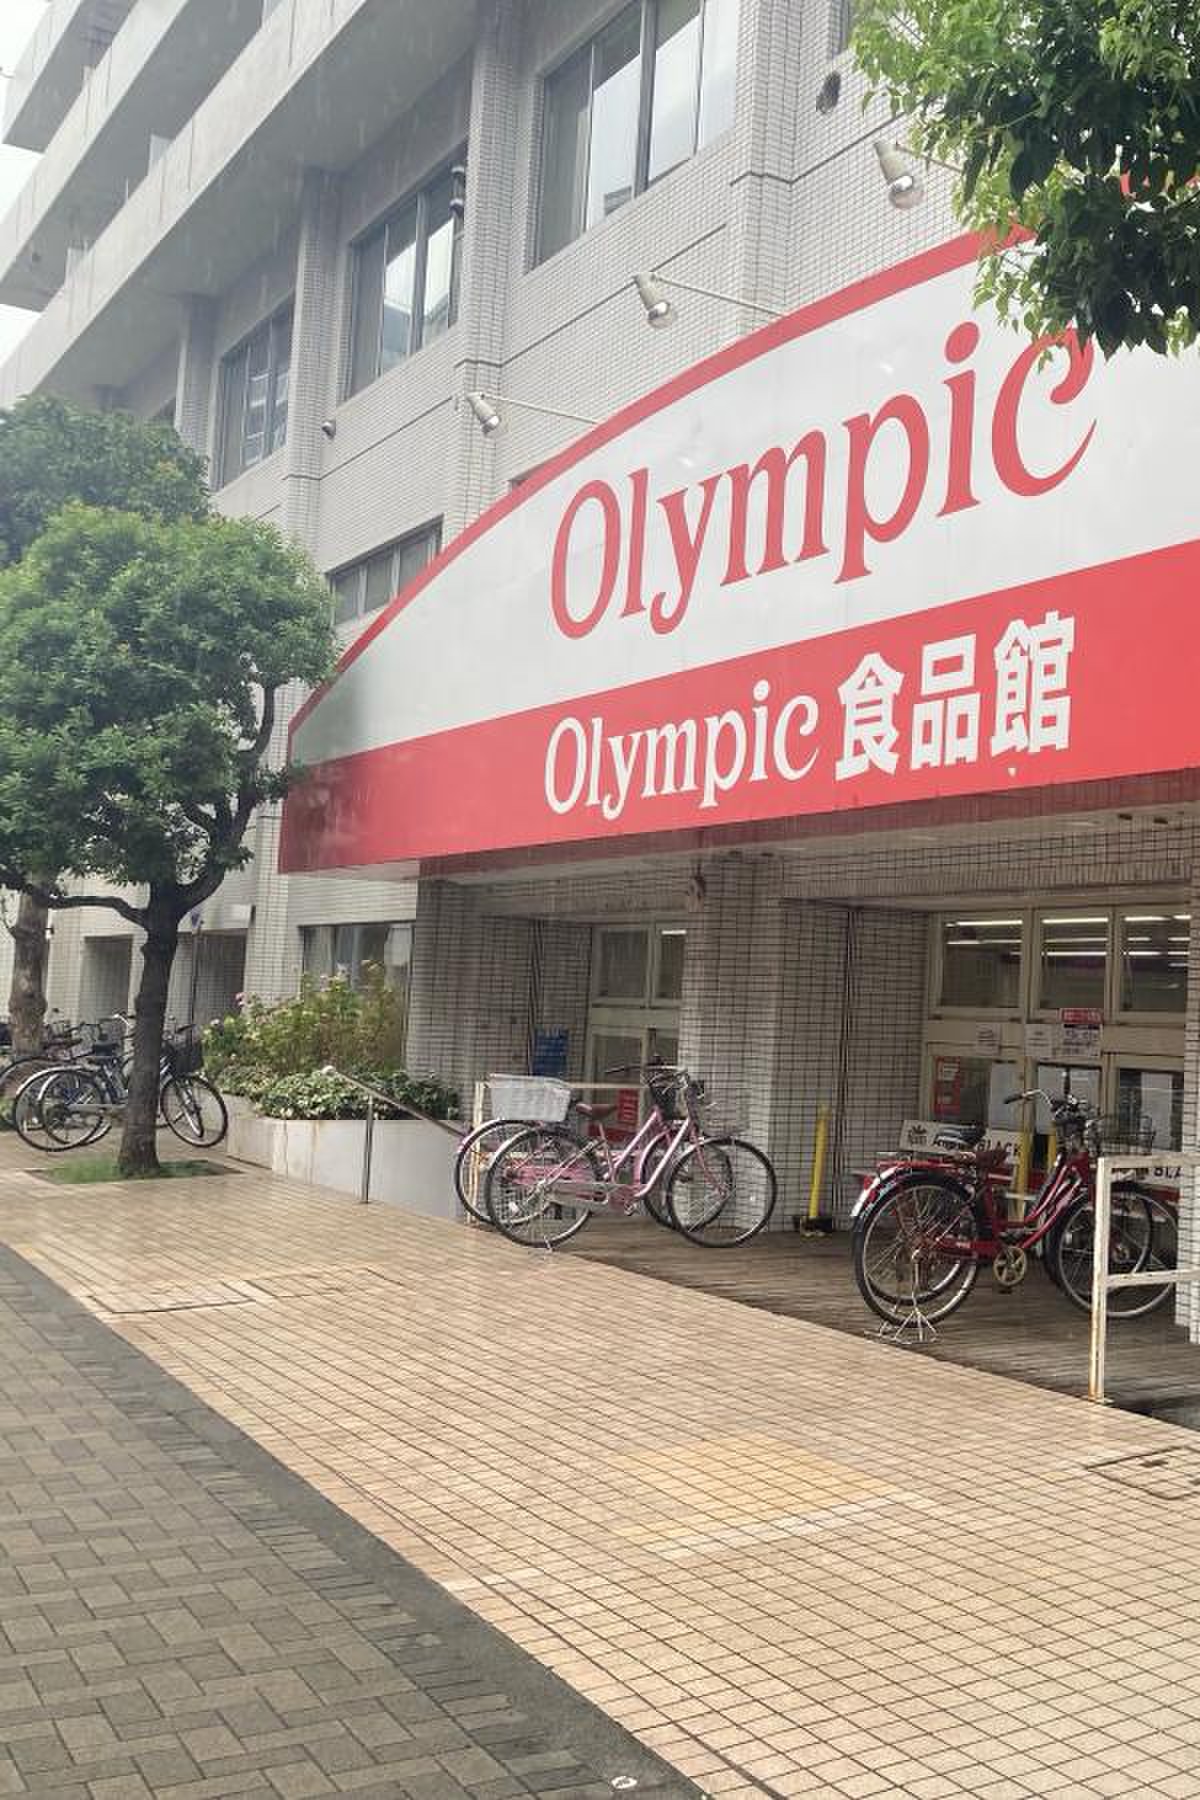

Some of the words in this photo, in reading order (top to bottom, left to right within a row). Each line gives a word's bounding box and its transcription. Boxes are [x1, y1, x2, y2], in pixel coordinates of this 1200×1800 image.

[551, 321, 1098, 640] Olympic
[544, 680, 820, 821] Olympic
[834, 610, 1076, 782] 食品館
